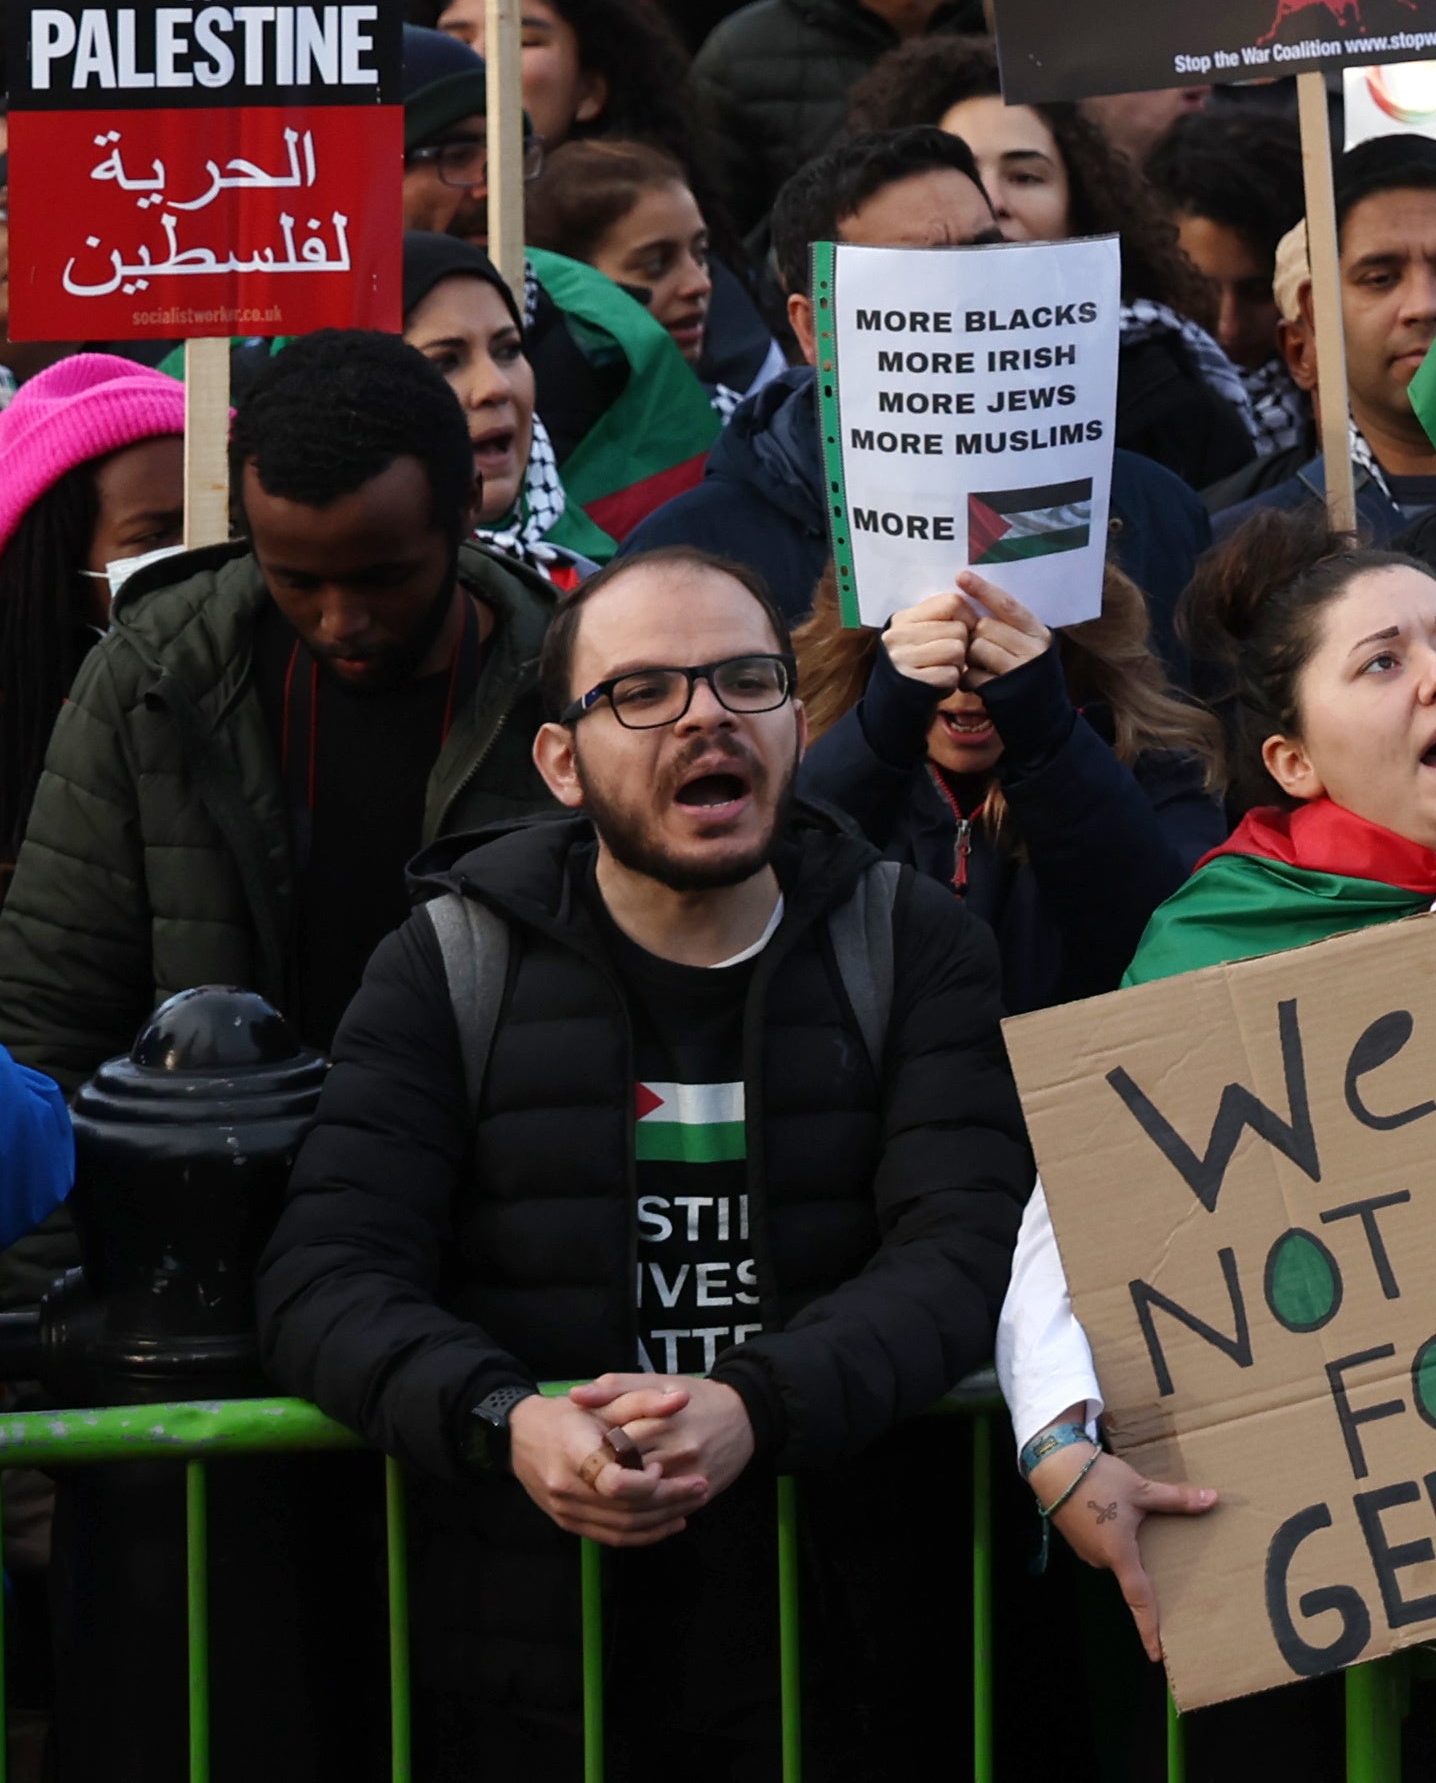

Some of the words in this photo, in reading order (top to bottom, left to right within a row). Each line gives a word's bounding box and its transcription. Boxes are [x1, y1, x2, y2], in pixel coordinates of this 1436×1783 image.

[30, 5, 380, 91] PALESTINE
[1174, 50, 1212, 74] Stop
[1216, 48, 1239, 70] the
[1241, 43, 1271, 68] War
[1273, 36, 1342, 65] Coalition
[90, 127, 318, 211] الحرية
[61, 211, 351, 299] لفلسطين
[856, 308, 953, 334] MORE
[964, 301, 1098, 334] BLACKS
[878, 350, 976, 375] MORE
[987, 343, 1077, 373] IRISH
[878, 390, 976, 415] MORE
[986, 383, 1077, 414] JEWS
[850, 427, 944, 456] MORE
[955, 419, 1104, 455] MUSLIMS
[852, 506, 956, 542] MORE
[636, 1257, 761, 1309] IVES
[1128, 1189, 1412, 1398] NOT
